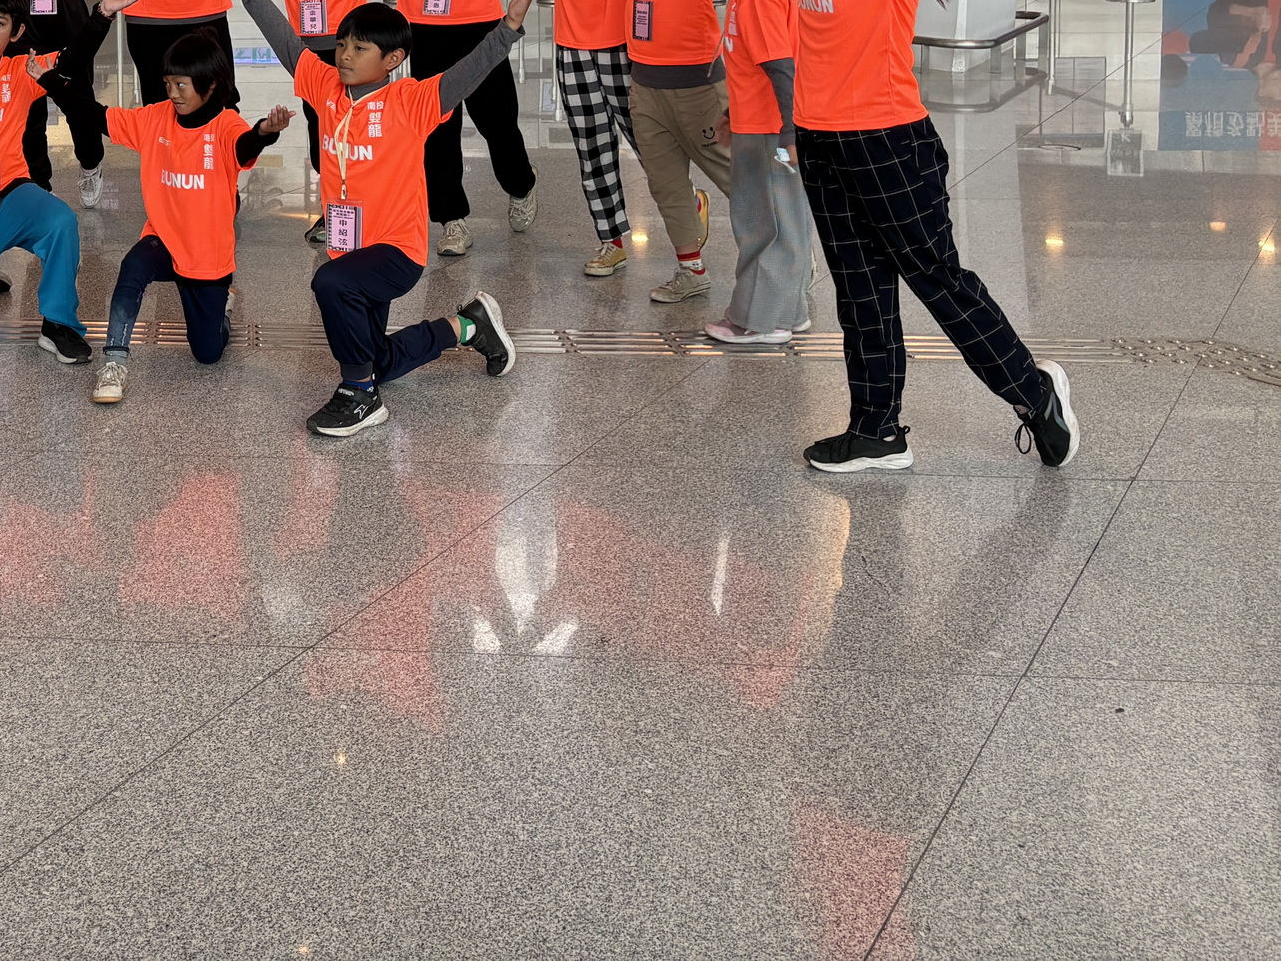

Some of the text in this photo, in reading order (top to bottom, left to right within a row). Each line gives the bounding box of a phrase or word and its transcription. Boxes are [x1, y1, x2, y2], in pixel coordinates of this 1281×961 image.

[366, 101, 385, 111] 南投
[368, 112, 383, 138] 雙龍
[161, 168, 205, 190] BUNUN
